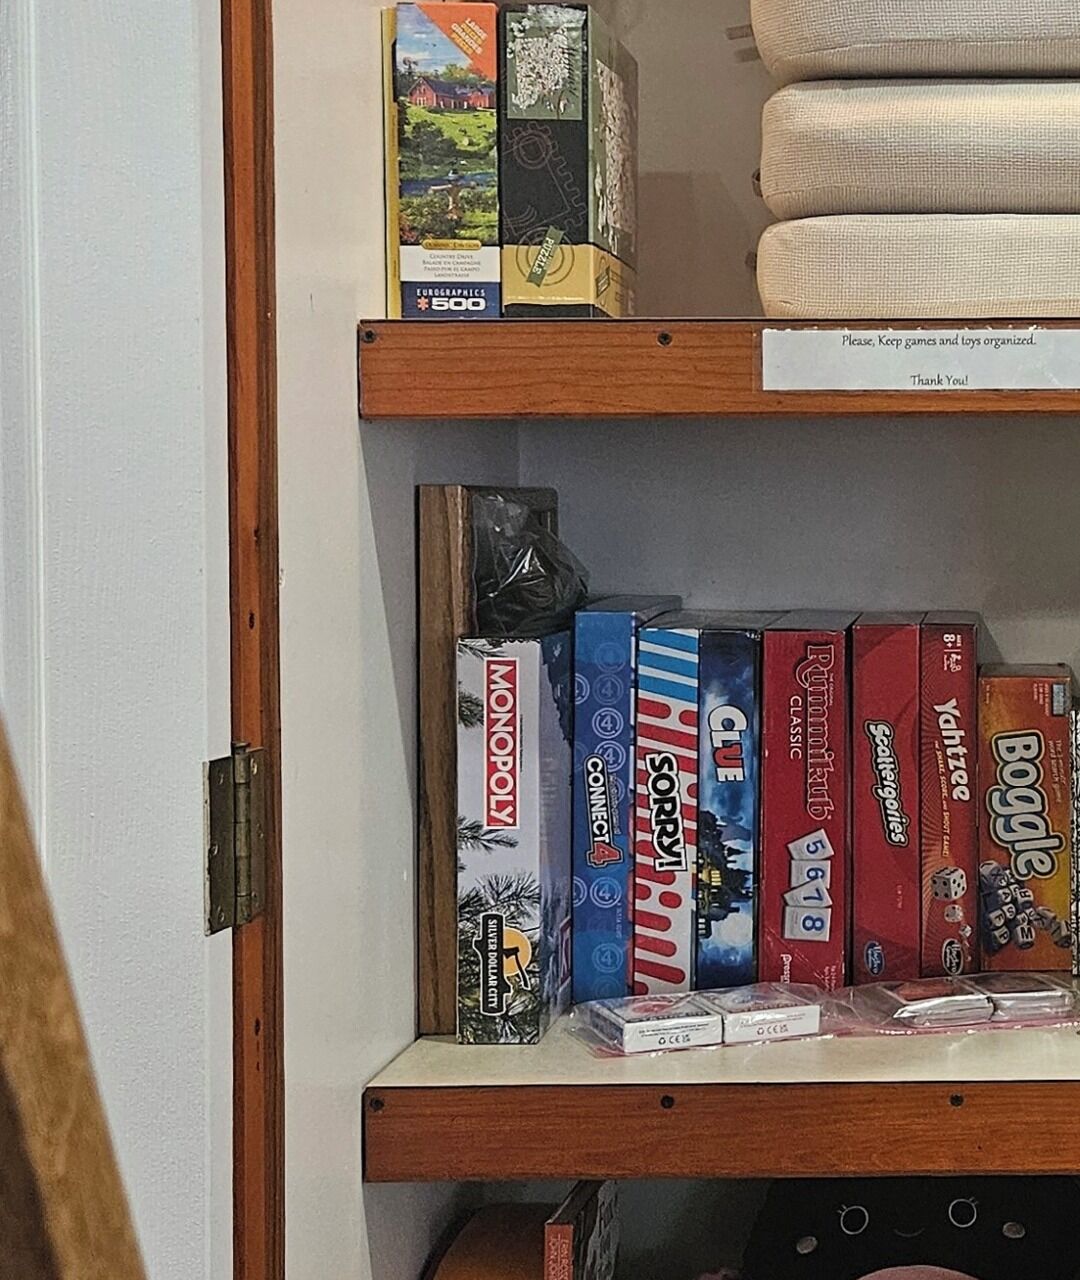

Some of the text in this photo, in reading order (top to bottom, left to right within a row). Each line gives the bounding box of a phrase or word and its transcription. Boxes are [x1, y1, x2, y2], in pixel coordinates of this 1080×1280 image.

[416, 288, 486, 297] EUROGRAPHICS
[532, 237, 555, 275] PUZZLE
[431, 297, 486, 311] 500
[841, 334, 1037, 349] Please, Keep games and toys organized.
[910, 375, 969, 387] Thank You!
[489, 663, 514, 824] MONOPOLY
[709, 705, 748, 782] CLUE
[790, 696, 802, 759] CLASSIC
[796, 645, 835, 821] Rummikub
[933, 698, 970, 801] Yahtzee
[587, 757, 610, 843] CONNECT
[648, 755, 683, 869] SORRY!
[869, 724, 907, 842] Scattergories
[942, 811, 950, 834] SHOUT
[991, 735, 1061, 875] Boggle
[590, 842, 621, 865] 4
[802, 840, 826, 932] 5 6 7 8
[488, 919, 498, 1009] SILVER DOLLAR CITY
